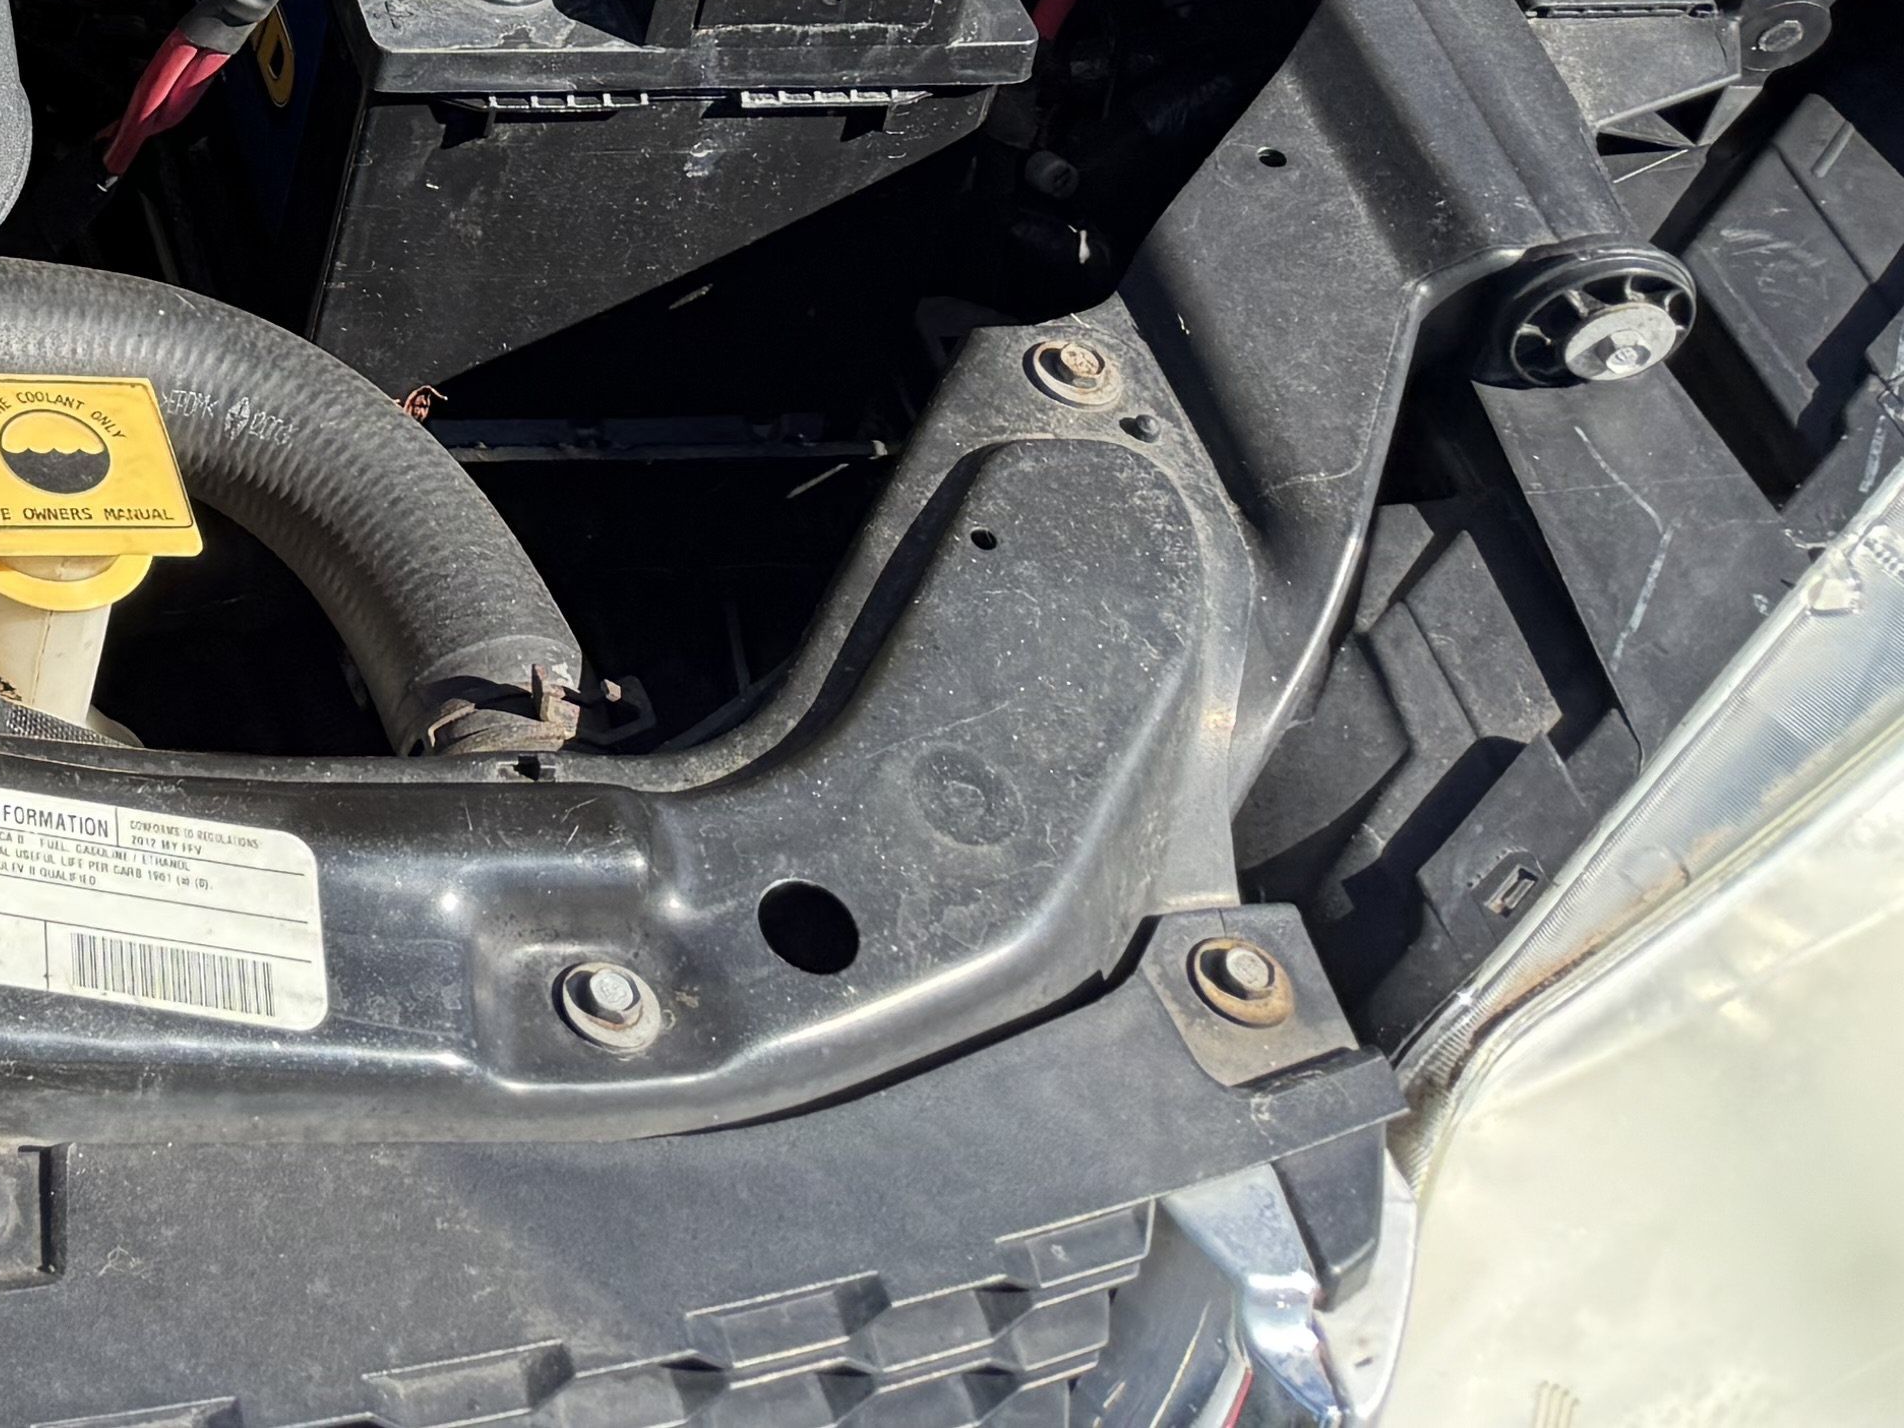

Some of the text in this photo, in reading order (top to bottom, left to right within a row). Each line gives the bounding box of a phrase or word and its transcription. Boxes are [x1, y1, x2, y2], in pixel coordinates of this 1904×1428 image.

[16, 391, 85, 411] COOLANT
[91, 411, 126, 439] ONLY
[23, 506, 92, 521] OWNERS
[103, 507, 174, 521] MANUAL
